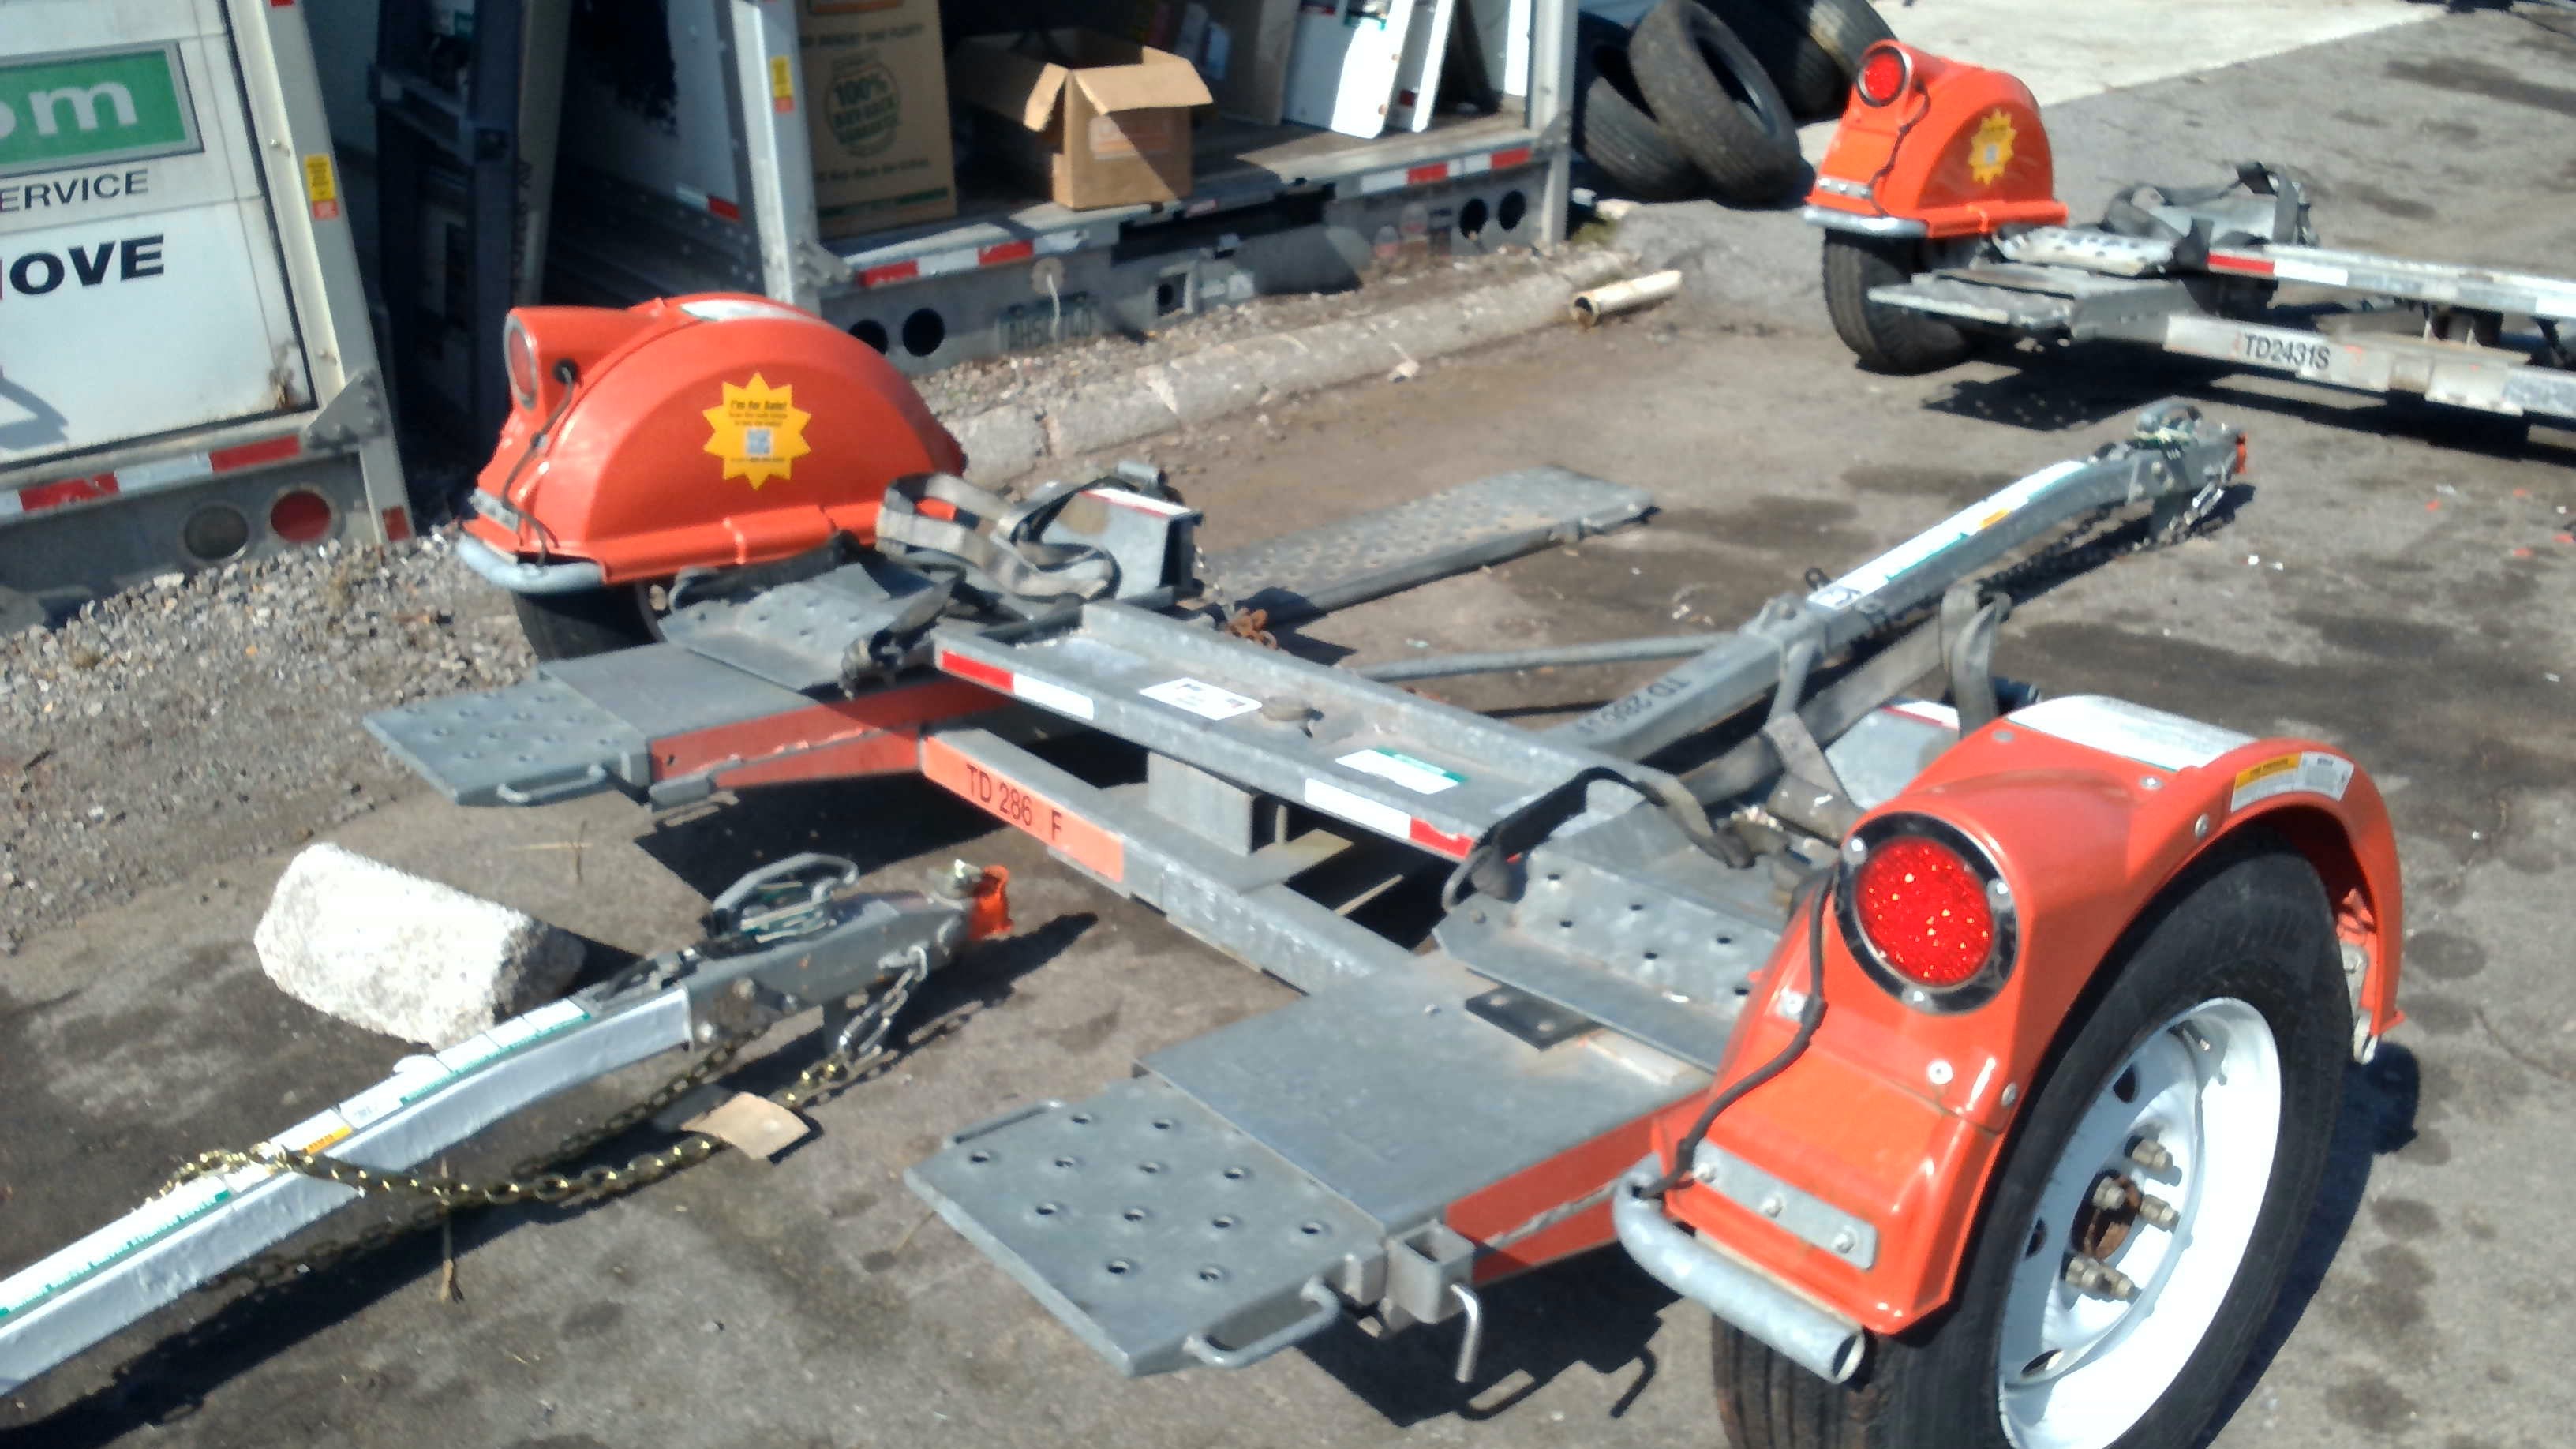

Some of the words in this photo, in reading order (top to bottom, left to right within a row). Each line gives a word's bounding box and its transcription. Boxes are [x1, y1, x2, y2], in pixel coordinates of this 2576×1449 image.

[0, 234, 164, 300] OVE
[2245, 332, 2331, 370] TD2431S
[966, 763, 992, 803] TD
[999, 781, 1033, 826] 286
[1050, 808, 1062, 841] F
